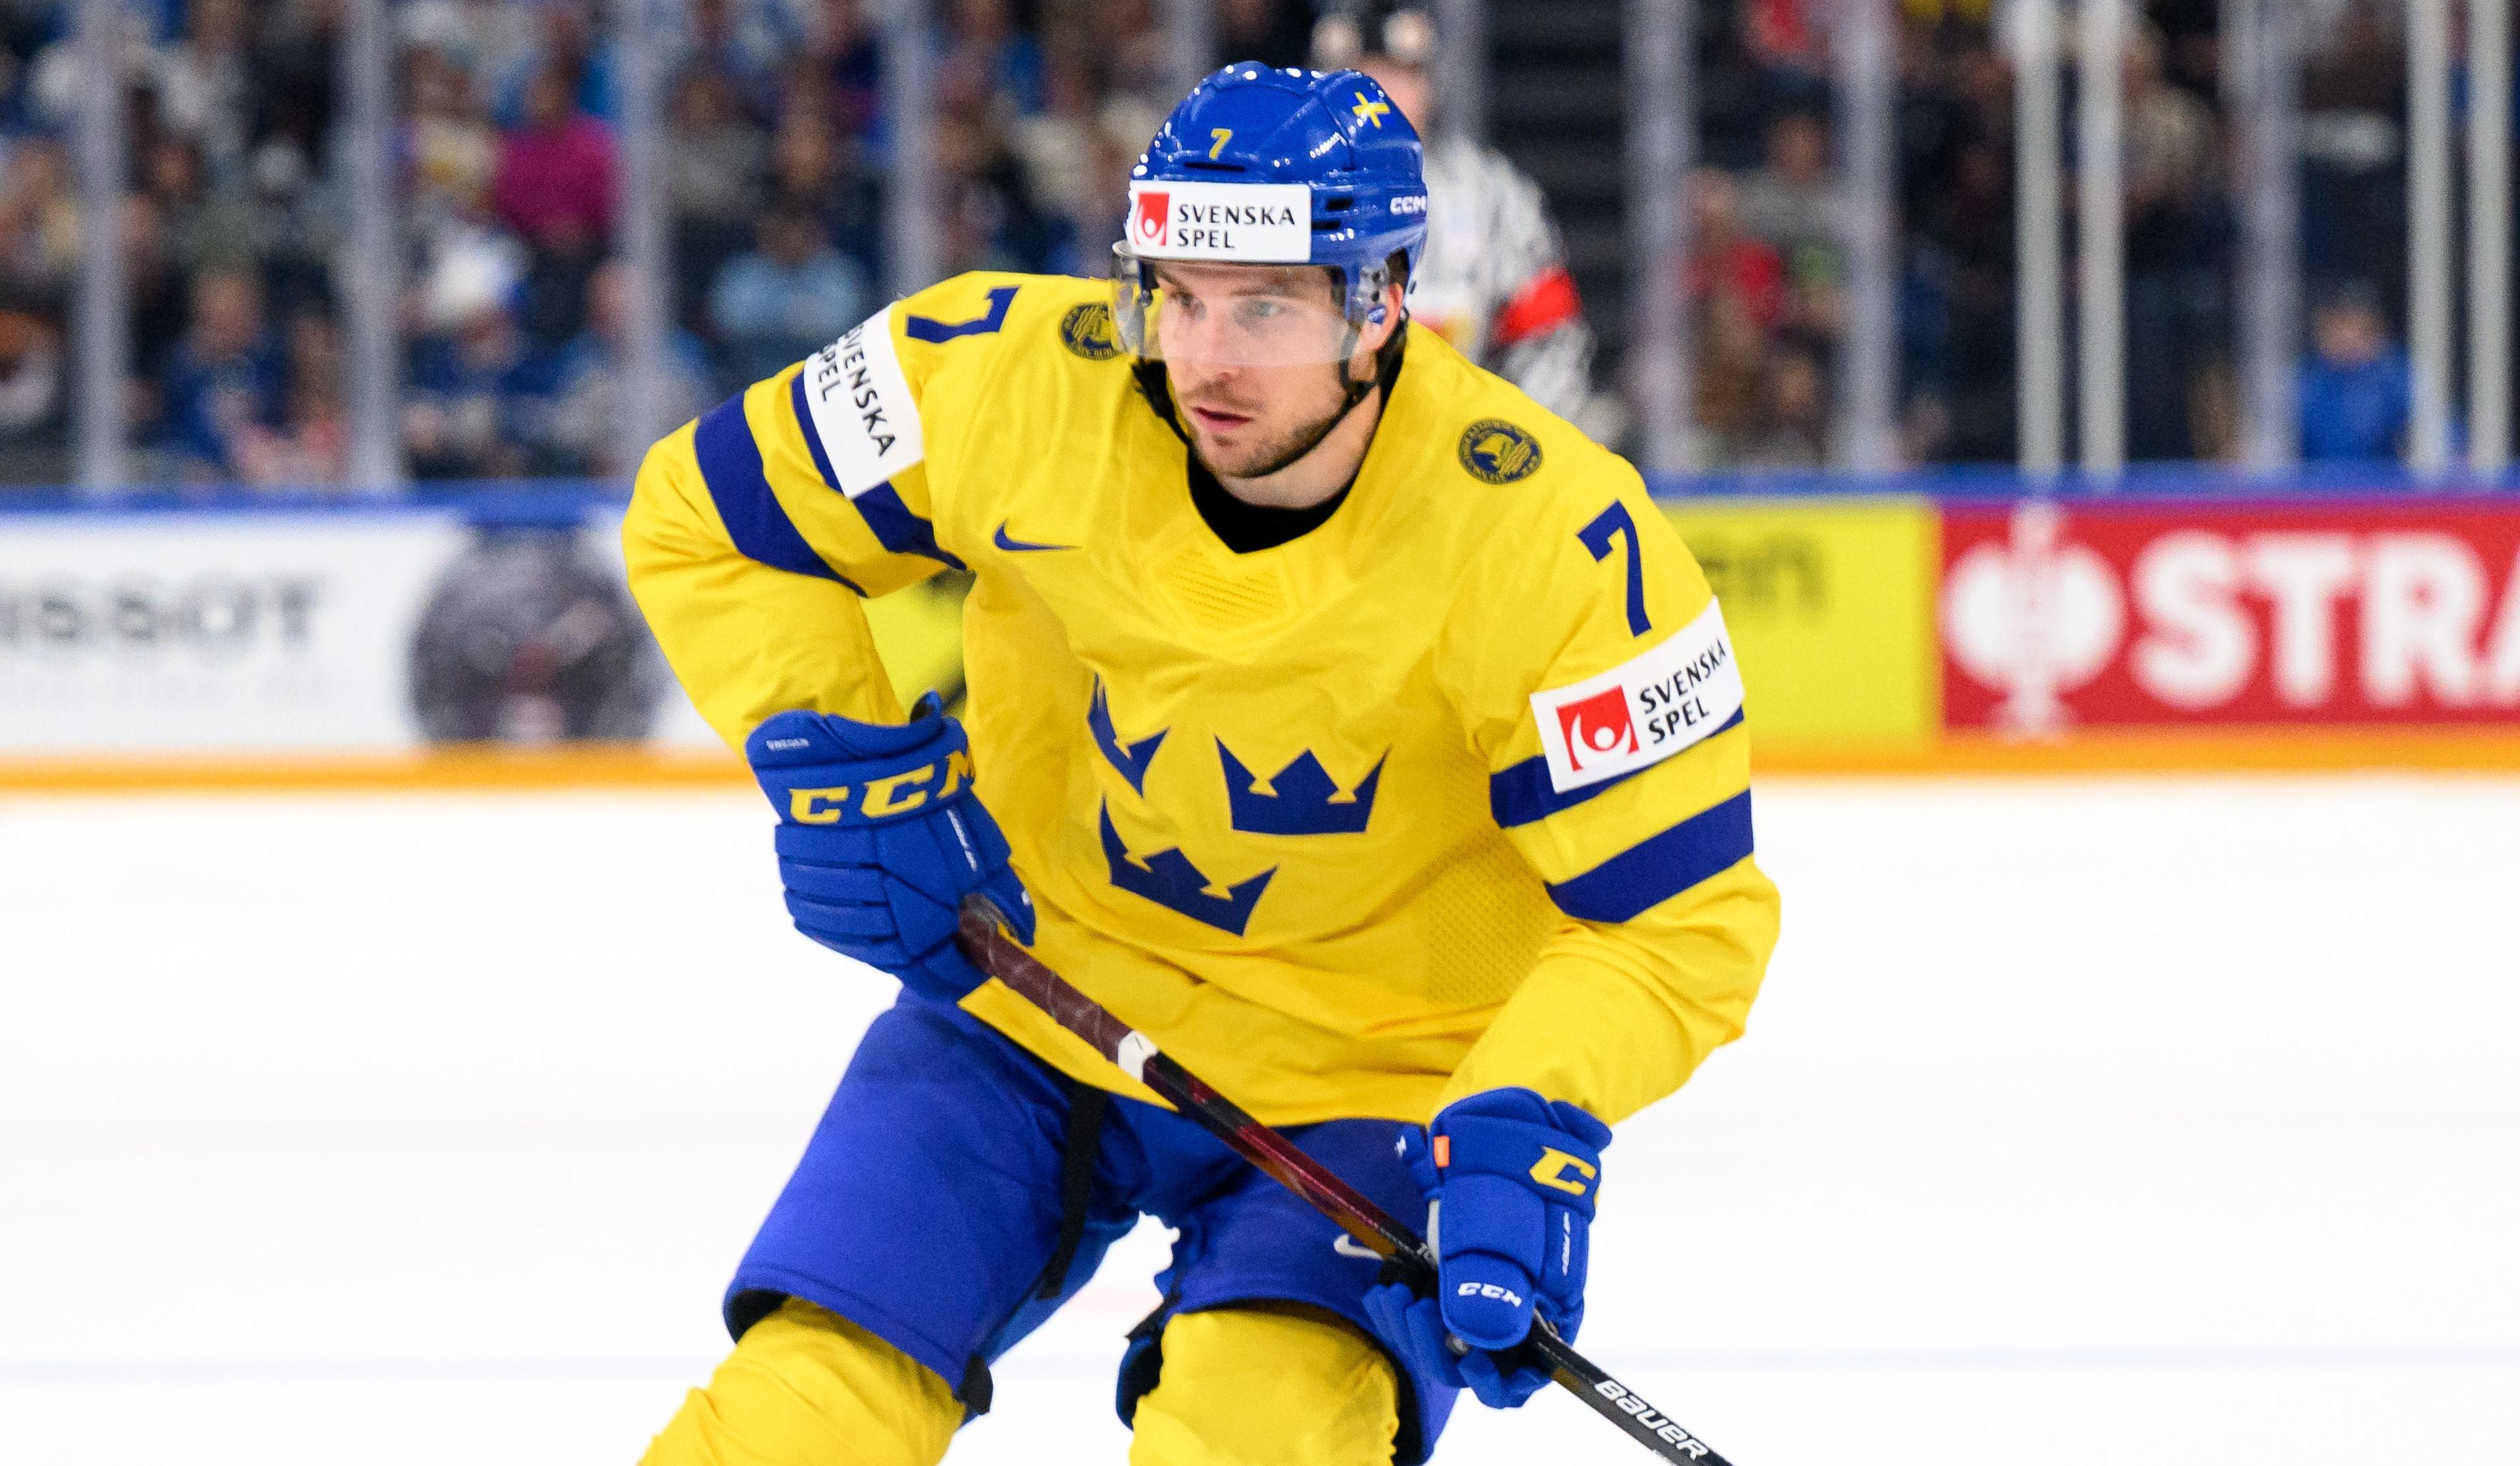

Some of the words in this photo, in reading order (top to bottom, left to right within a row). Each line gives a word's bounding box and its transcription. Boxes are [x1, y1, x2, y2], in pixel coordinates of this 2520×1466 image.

[1209, 128, 1233, 160] 7
[1177, 203, 1296, 226] SVENSKA
[1390, 196, 1427, 215] CCM
[1177, 228, 1236, 250] SPEL
[905, 284, 1023, 344] 7
[1576, 498, 1652, 638] 7
[1639, 636, 1727, 714] SVENSKA
[1647, 694, 1711, 744] SPEL
[789, 750, 976, 825] CCM
[1457, 1282, 1523, 1308] CCM
